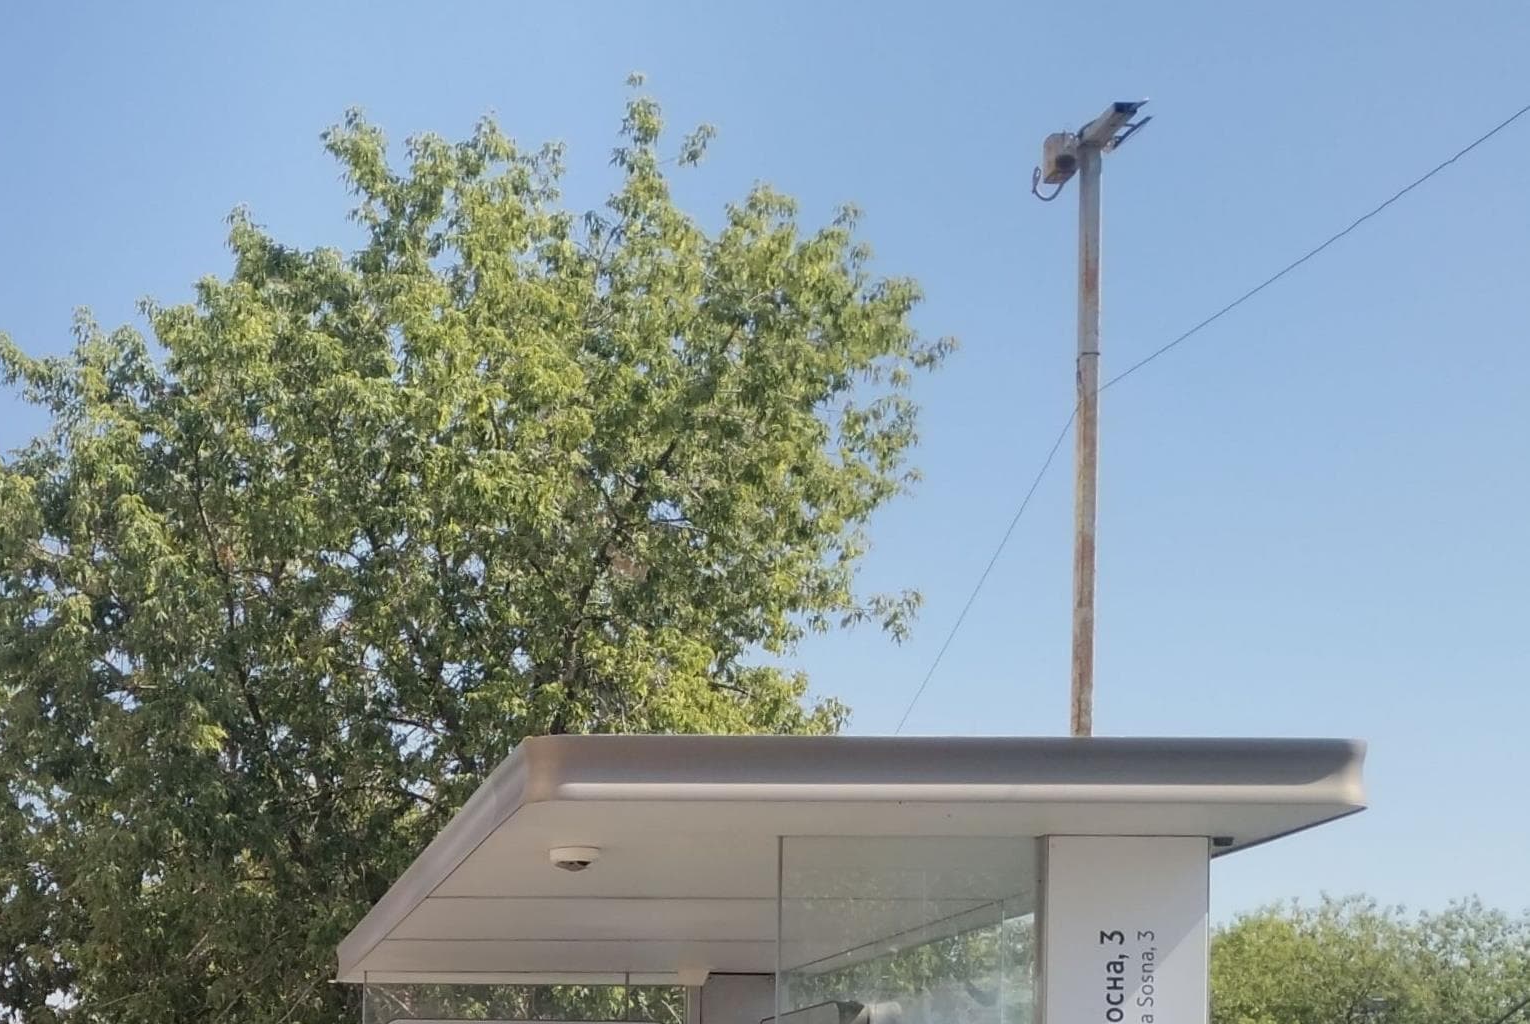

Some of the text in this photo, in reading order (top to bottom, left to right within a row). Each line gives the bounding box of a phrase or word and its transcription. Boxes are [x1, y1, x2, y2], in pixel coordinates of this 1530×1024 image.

[1099, 930, 1125, 945] 3
[1137, 930, 1155, 941] 3
[1136, 947, 1158, 1007] Sosna,
